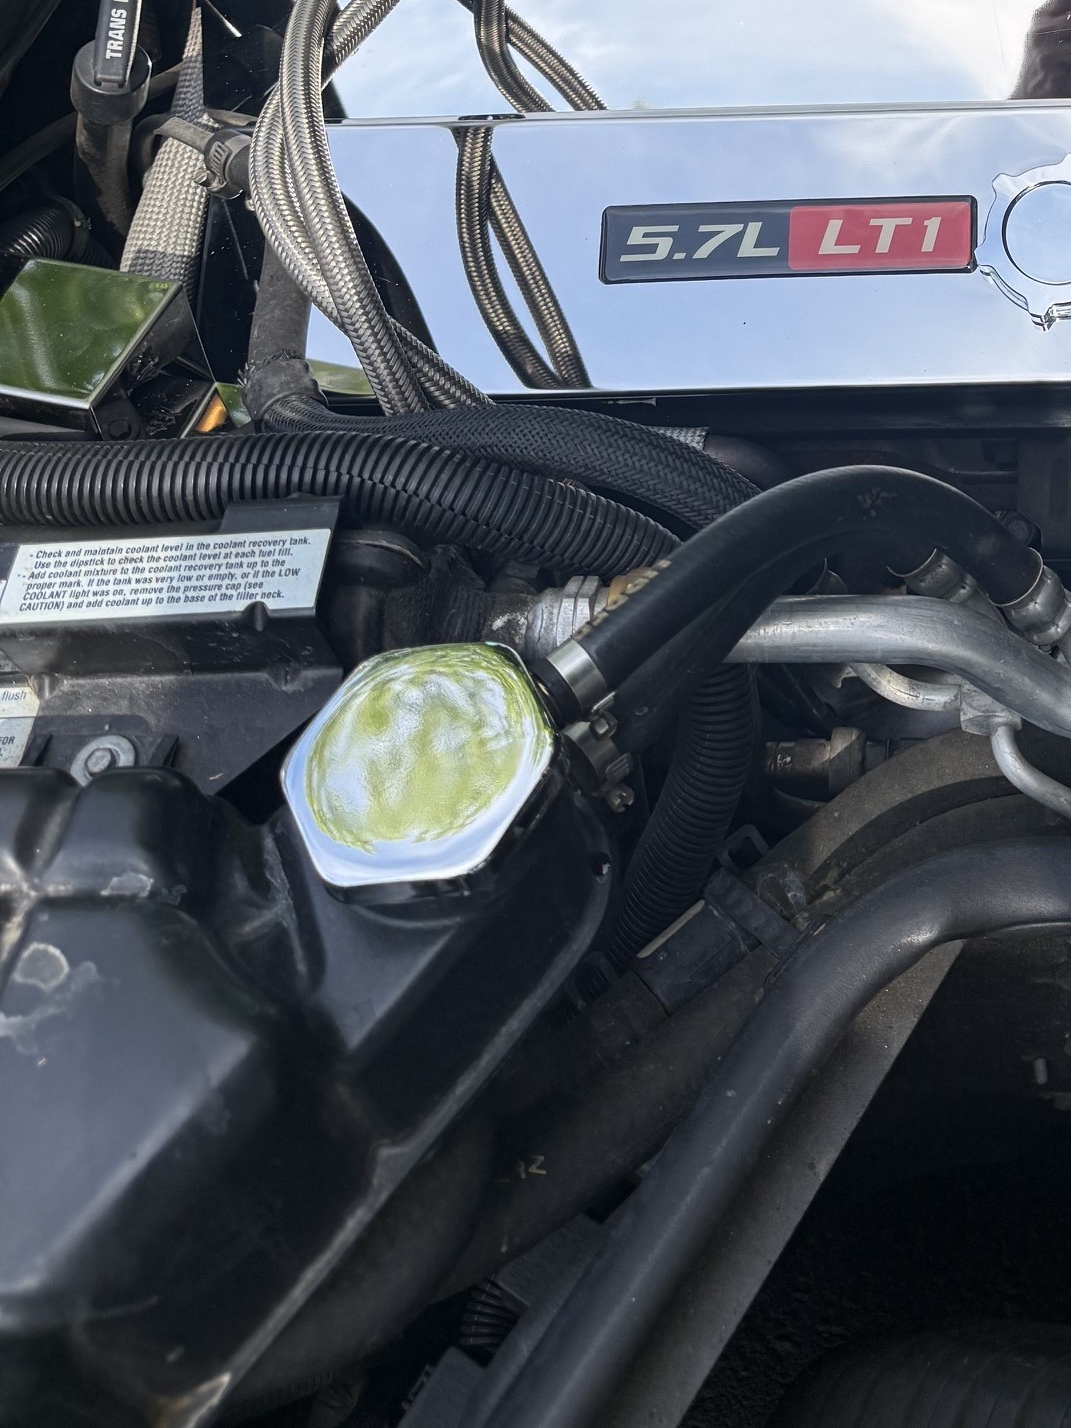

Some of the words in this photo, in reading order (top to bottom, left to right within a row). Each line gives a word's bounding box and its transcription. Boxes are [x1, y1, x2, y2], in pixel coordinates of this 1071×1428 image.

[105, 8, 128, 60] TRANS
[619, 220, 782, 262] 5.7L
[817, 215, 943, 255] LT1
[33, 560, 51, 569] Use
[53, 559, 68, 568] the
[69, 556, 105, 567] dipstick
[107, 557, 116, 565] to
[117, 554, 144, 565] check
[146, 554, 161, 563] the
[162, 552, 197, 562] coolant
[198, 550, 221, 560] level
[222, 550, 232, 559] at
[234, 548, 256, 558] each
[258, 547, 276, 557] fuel
[277, 547, 293, 556] fill.
[35, 549, 63, 559] Check
[64, 547, 82, 557] and
[83, 545, 123, 556] maintain
[124, 544, 159, 554] coolant
[160, 542, 183, 552] level
[184, 542, 194, 551] in
[196, 541, 210, 550] the
[212, 539, 246, 549] coolant
[247, 538, 287, 547] recovery
[289, 536, 310, 545] tank.
[25, 581, 57, 591] proper
[58, 578, 83, 588] mark.
[86, 578, 94, 587] If
[95, 577, 110, 586] the
[112, 576, 132, 585] tank
[134, 576, 153, 584] was
[155, 575, 175, 584] very
[176, 573, 193, 582] low
[195, 573, 206, 581] or
[207, 571, 237, 581] empty,
[240, 571, 250, 579] or
[252, 569, 260, 578] if
[261, 569, 276, 578] the
[278, 567, 300, 577] LOW
[27, 570, 46, 580] Add
[47, 568, 82, 578] coolant
[83, 567, 118, 576] mixture
[119, 566, 129, 575] to
[131, 565, 145, 574] the
[147, 563, 182, 573] coolant
[183, 562, 223, 571] recovery
[224, 560, 244, 569] tank
[246, 561, 257, 569] up
[260, 559, 269, 567] to
[271, 558, 285, 567] the
[18, 600, 64, 611] CAUTION)
[66, 599, 84, 609] and
[85, 598, 104, 608] add
[104, 596, 139, 607] coolant
[140, 597, 152, 606] up
[154, 595, 164, 604] to
[166, 594, 181, 603] the
[183, 594, 205, 603] base
[207, 592, 218, 601] of
[219, 592, 233, 601] the
[235, 590, 259, 600] filler
[260, 589, 284, 599] neck.
[22, 589, 68, 601] COOLANT
[68, 588, 90, 598] light
[91, 589, 110, 597] was
[112, 588, 126, 596] on,
[129, 586, 164, 595] remove
[166, 584, 181, 593] the
[182, 583, 223, 593] pressure
[224, 582, 241, 590] cap
[243, 580, 263, 590] (see
[2, 690, 27, 701] flush
